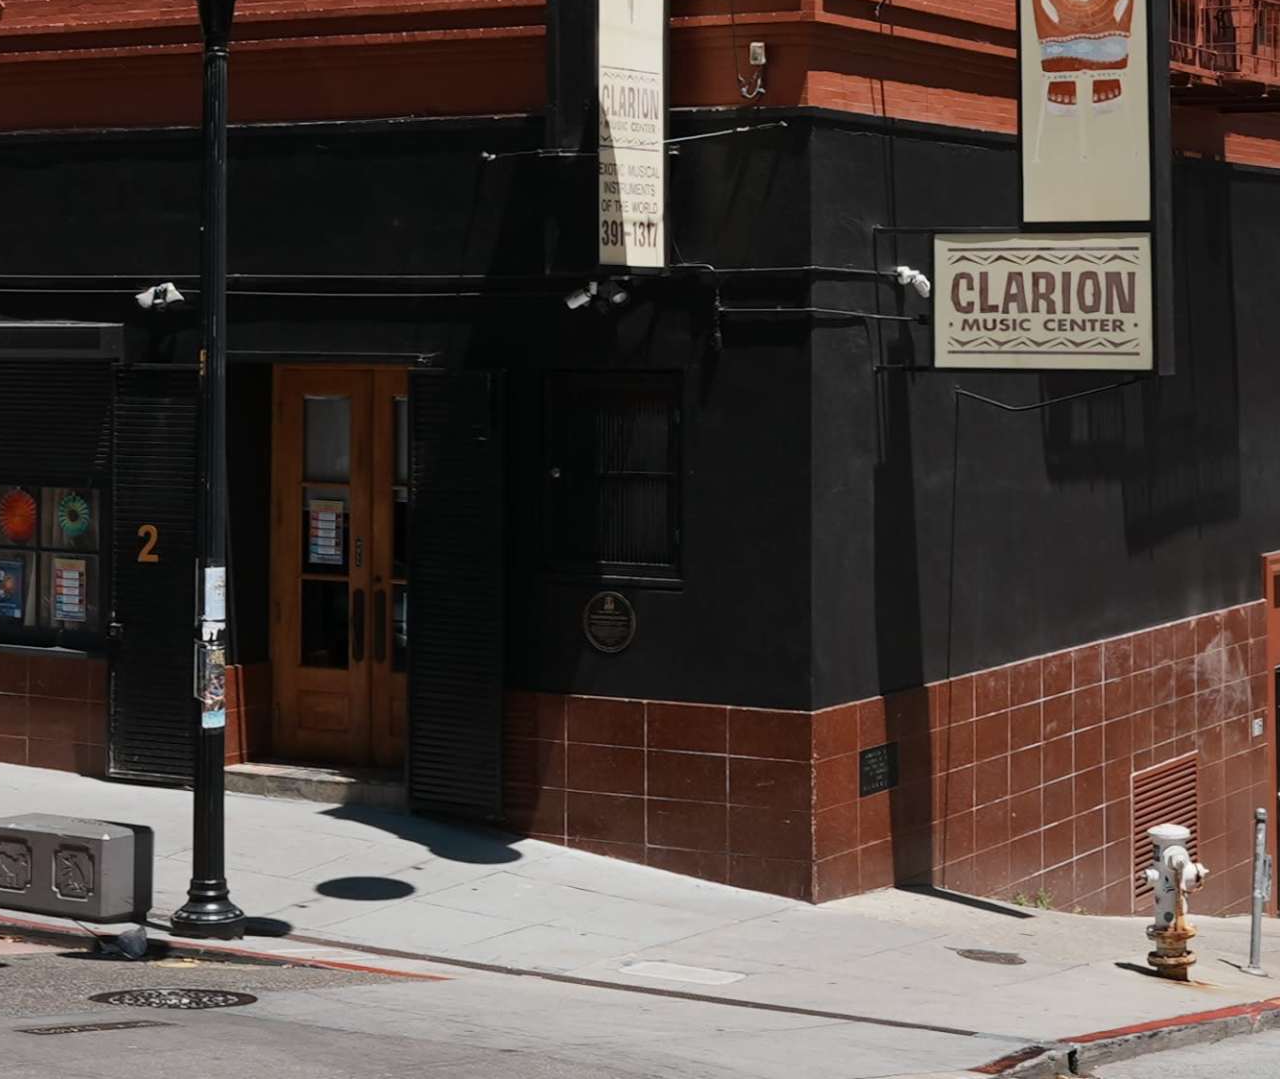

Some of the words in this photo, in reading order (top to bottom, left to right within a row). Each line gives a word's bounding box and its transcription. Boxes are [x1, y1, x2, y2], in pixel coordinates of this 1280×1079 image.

[602, 84, 660, 121] CLARION
[631, 122, 656, 133] CENTER
[603, 180, 656, 197] INSTRUMENTS
[601, 199, 613, 212] OF
[631, 201, 657, 215] WORLD
[602, 220, 658, 248] 391-1317
[951, 271, 1136, 315] CLARION
[961, 318, 1032, 332] MUSIC
[1043, 318, 1126, 333] CENTER
[137, 524, 159, 562] 2
